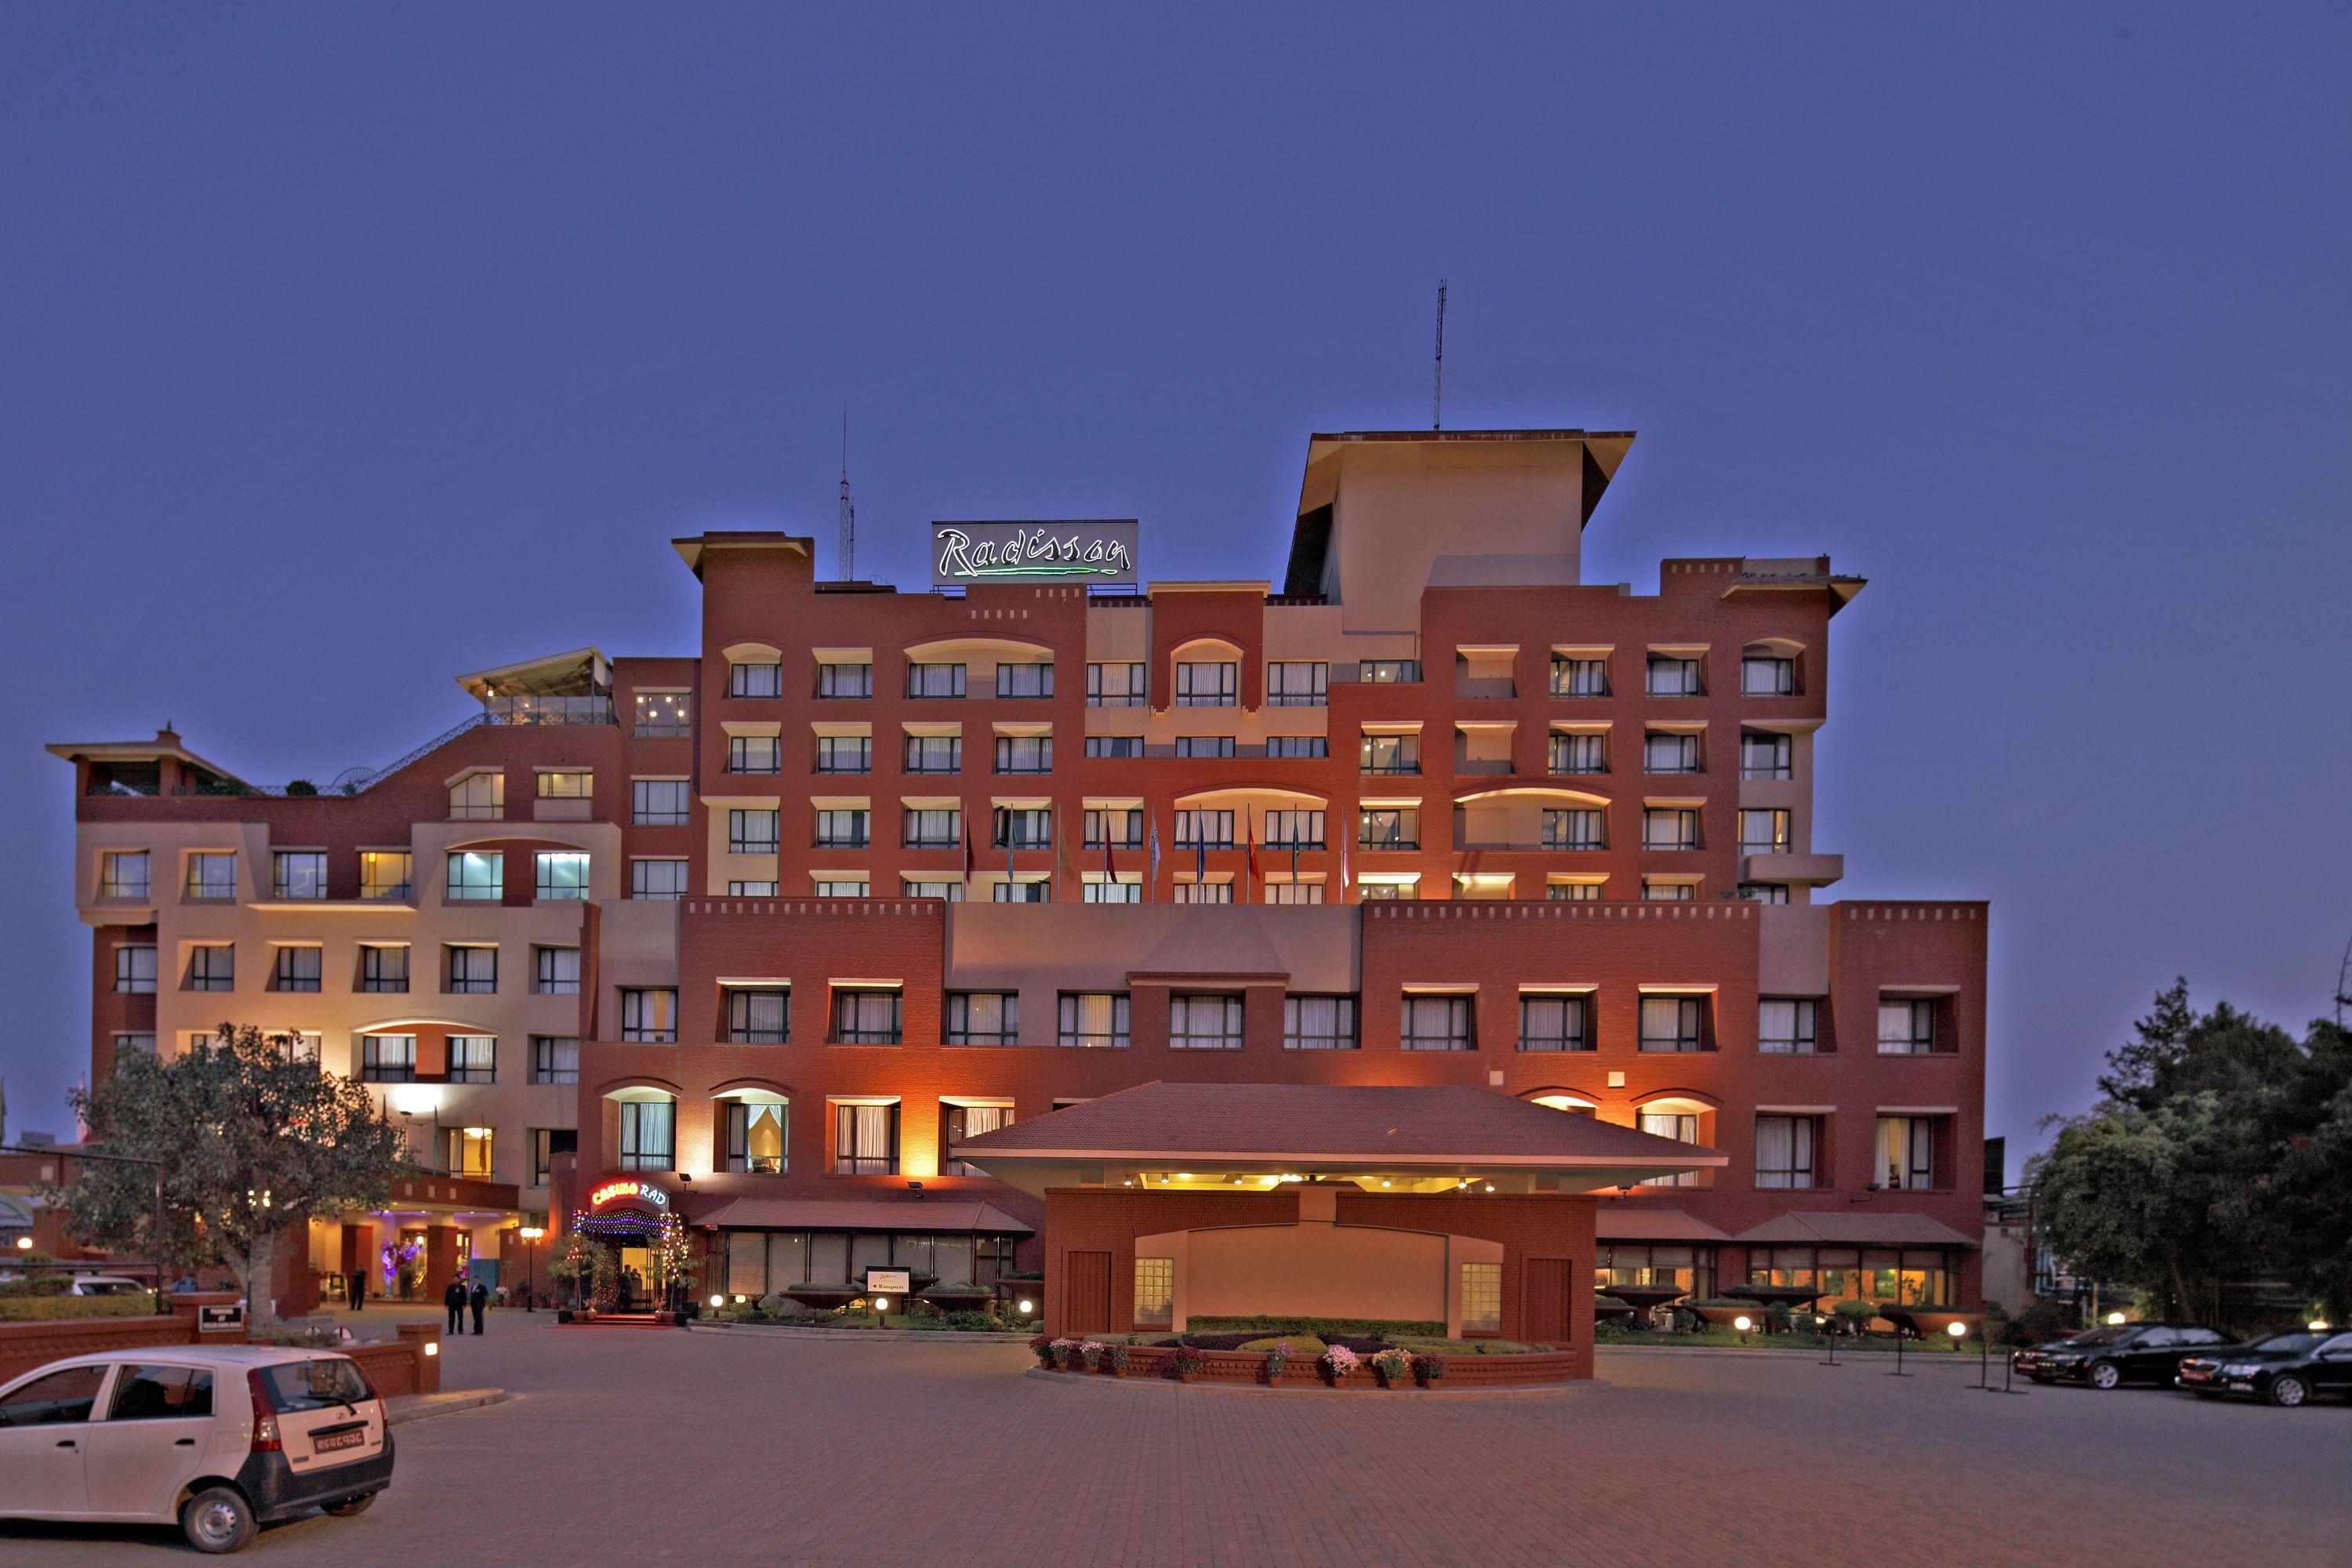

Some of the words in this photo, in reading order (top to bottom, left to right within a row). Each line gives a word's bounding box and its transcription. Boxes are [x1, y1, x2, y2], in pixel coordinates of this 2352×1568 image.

[938, 528, 1131, 577] Radisson
[592, 1181, 639, 1205] CASINO
[640, 1184, 666, 1205] RAD
